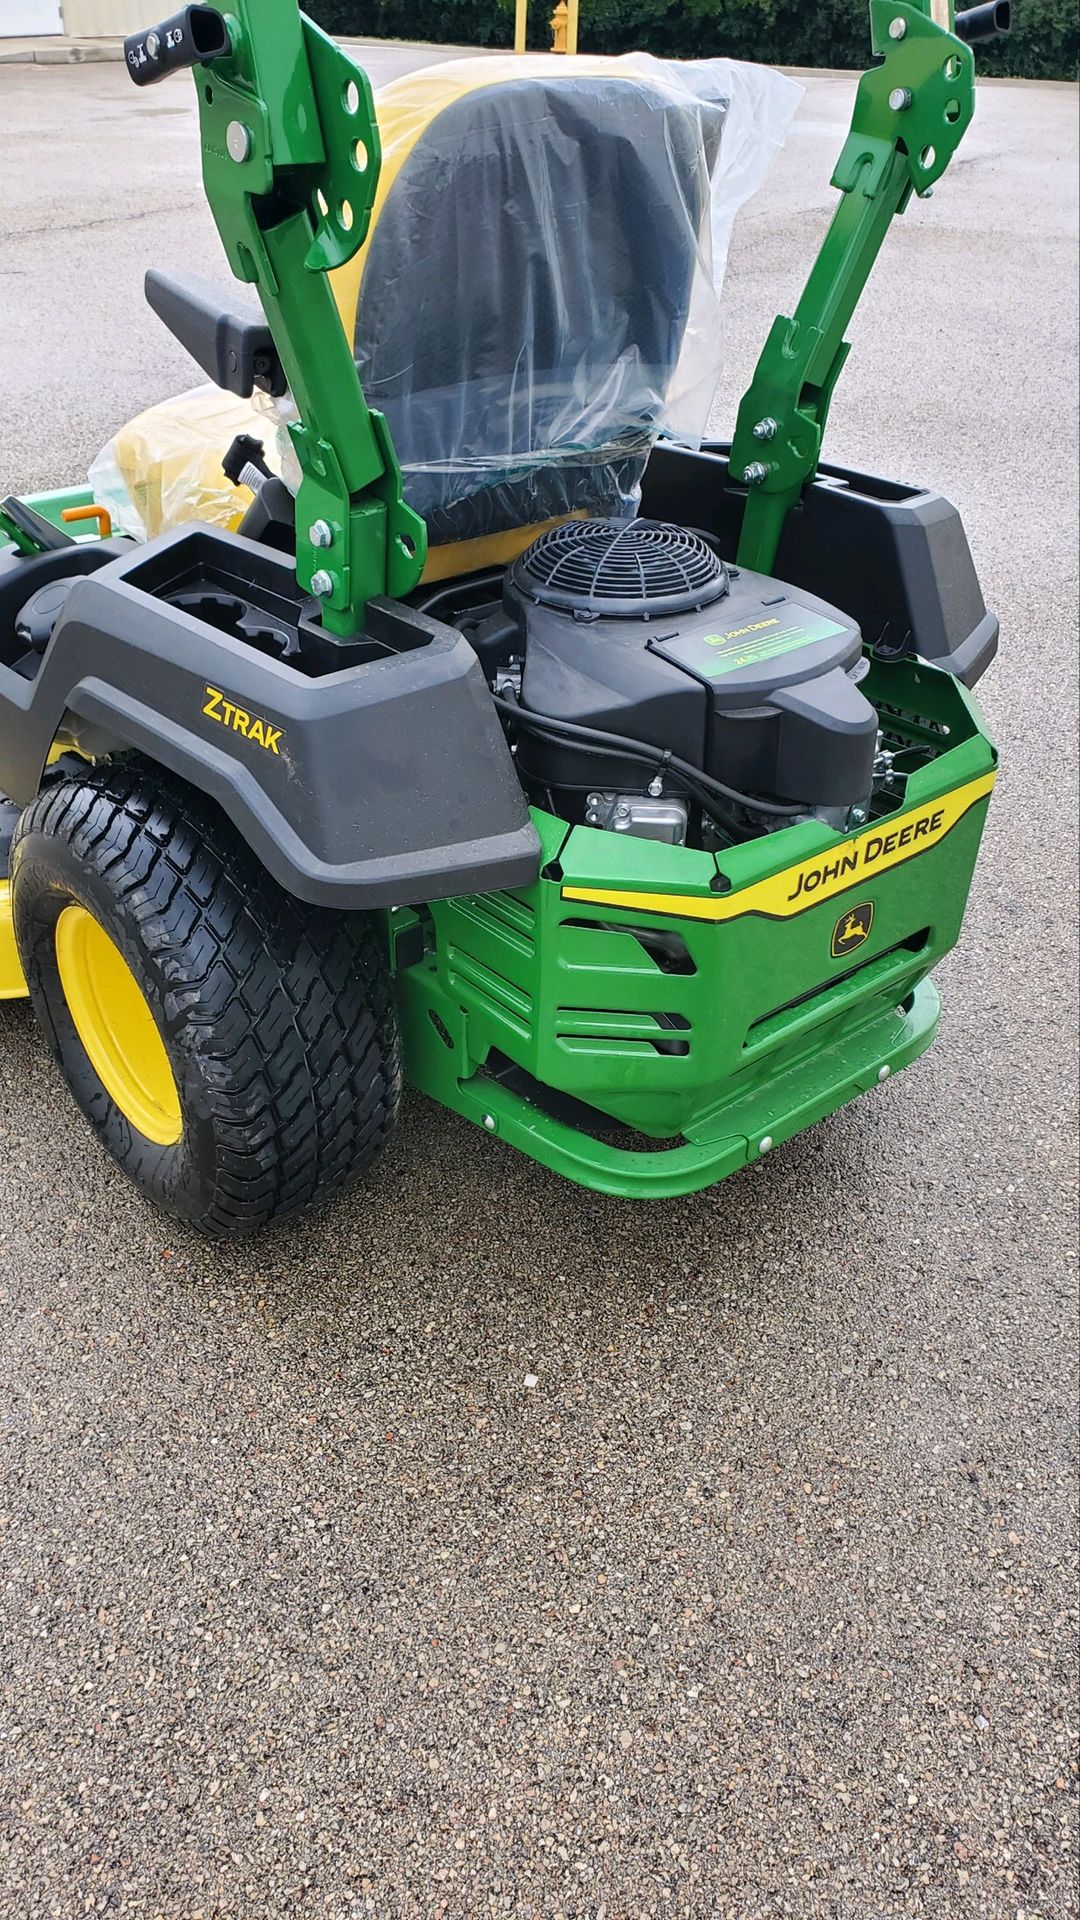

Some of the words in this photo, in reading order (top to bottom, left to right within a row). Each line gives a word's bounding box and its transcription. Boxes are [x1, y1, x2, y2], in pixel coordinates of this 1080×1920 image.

[725, 627, 750, 639] JOHN
[748, 618, 780, 631] DEERE
[202, 686, 283, 756] ZTRAK
[787, 851, 859, 902] JOHN
[863, 809, 945, 865] DEERE
